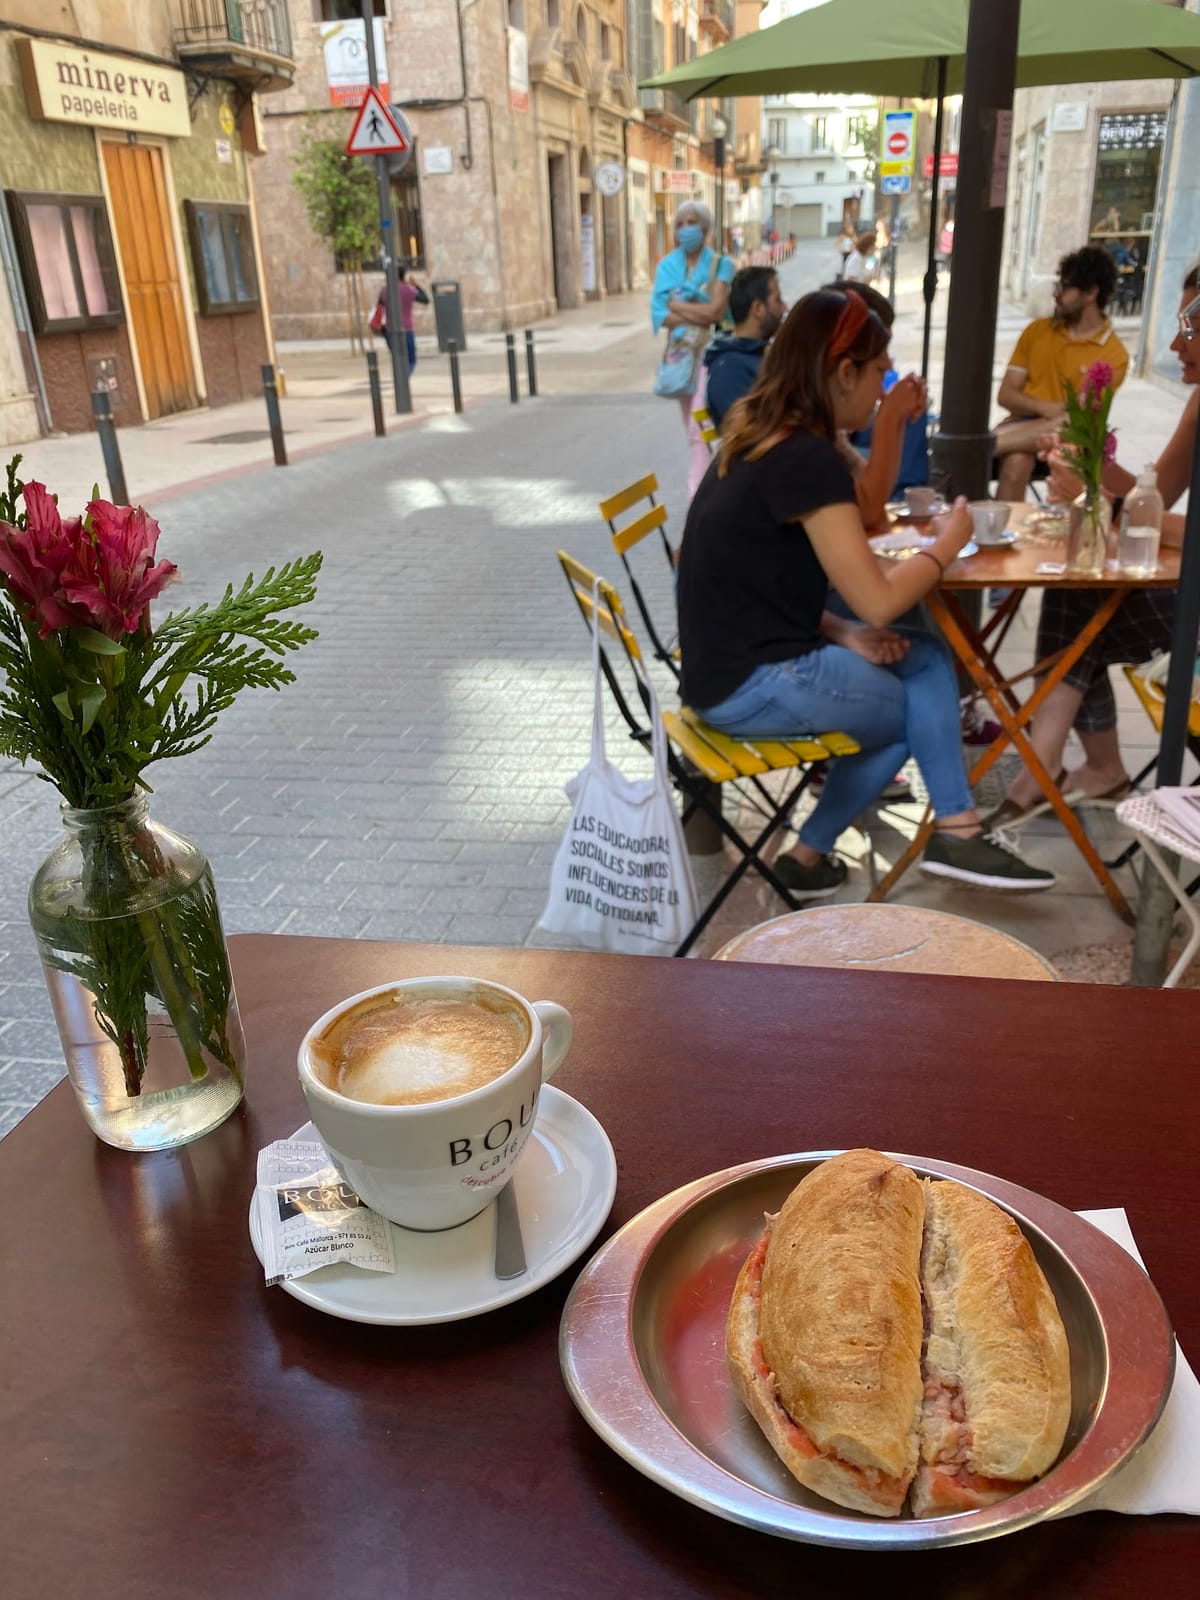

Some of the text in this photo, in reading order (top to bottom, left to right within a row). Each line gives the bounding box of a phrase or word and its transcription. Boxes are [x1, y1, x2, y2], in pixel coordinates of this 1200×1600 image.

[56, 54, 171, 103] minerva
[61, 94, 138, 121] papeleria
[573, 816, 595, 833] LAS
[571, 840, 668, 879] SOCIALES SOMOS
[568, 864, 648, 903] INFLUENCERS
[651, 886, 665, 902] DE
[565, 887, 661, 926] VIDA COTIDIANA
[449, 1090, 535, 1167] BOU
[305, 1242, 354, 1254] Azúcar Blanco
[310, 1235, 333, 1244] Mallorca
